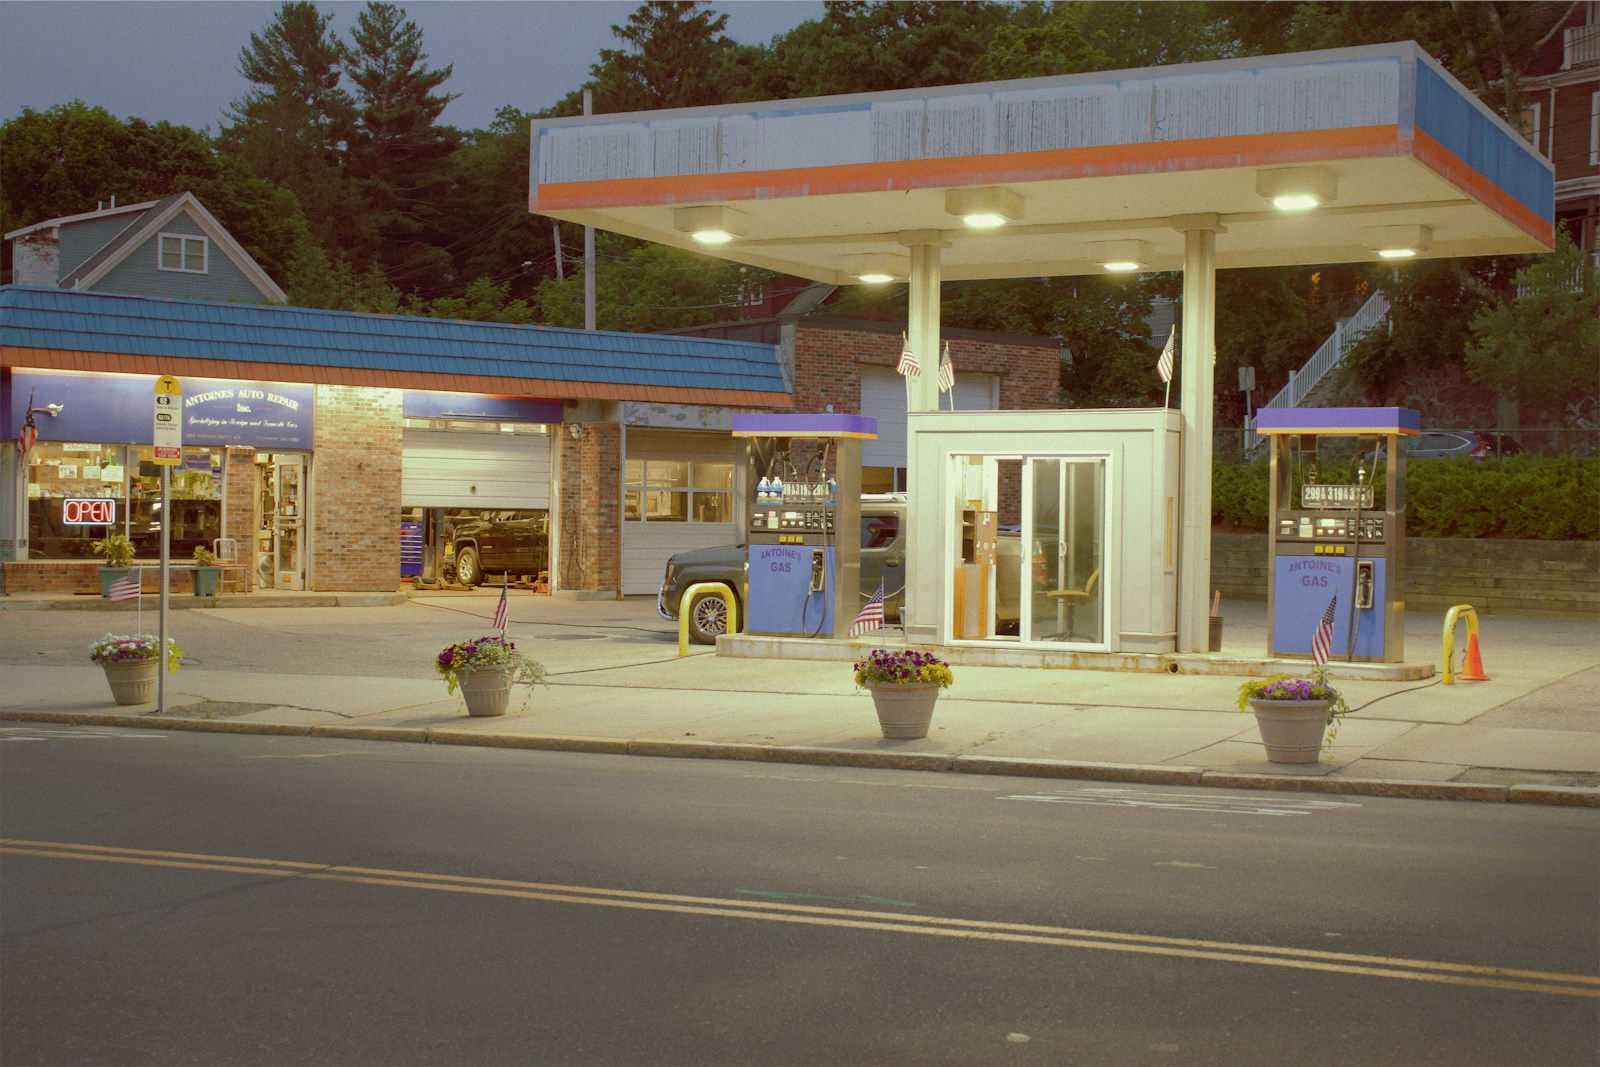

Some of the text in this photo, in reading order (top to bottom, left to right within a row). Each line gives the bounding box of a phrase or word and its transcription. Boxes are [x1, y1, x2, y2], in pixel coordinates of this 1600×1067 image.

[164, 381, 173, 390] T
[238, 389, 265, 400] AUTO
[267, 393, 299, 411] REPAIR
[237, 403, 252, 413] Inc.
[188, 416, 221, 426] Specializing
[66, 501, 112, 522] OPEN
[760, 548, 802, 561] ANTOINE'S
[771, 561, 791, 573] GAS
[1288, 559, 1342, 575] ANTOINE'S
[1302, 575, 1328, 588] GAS
